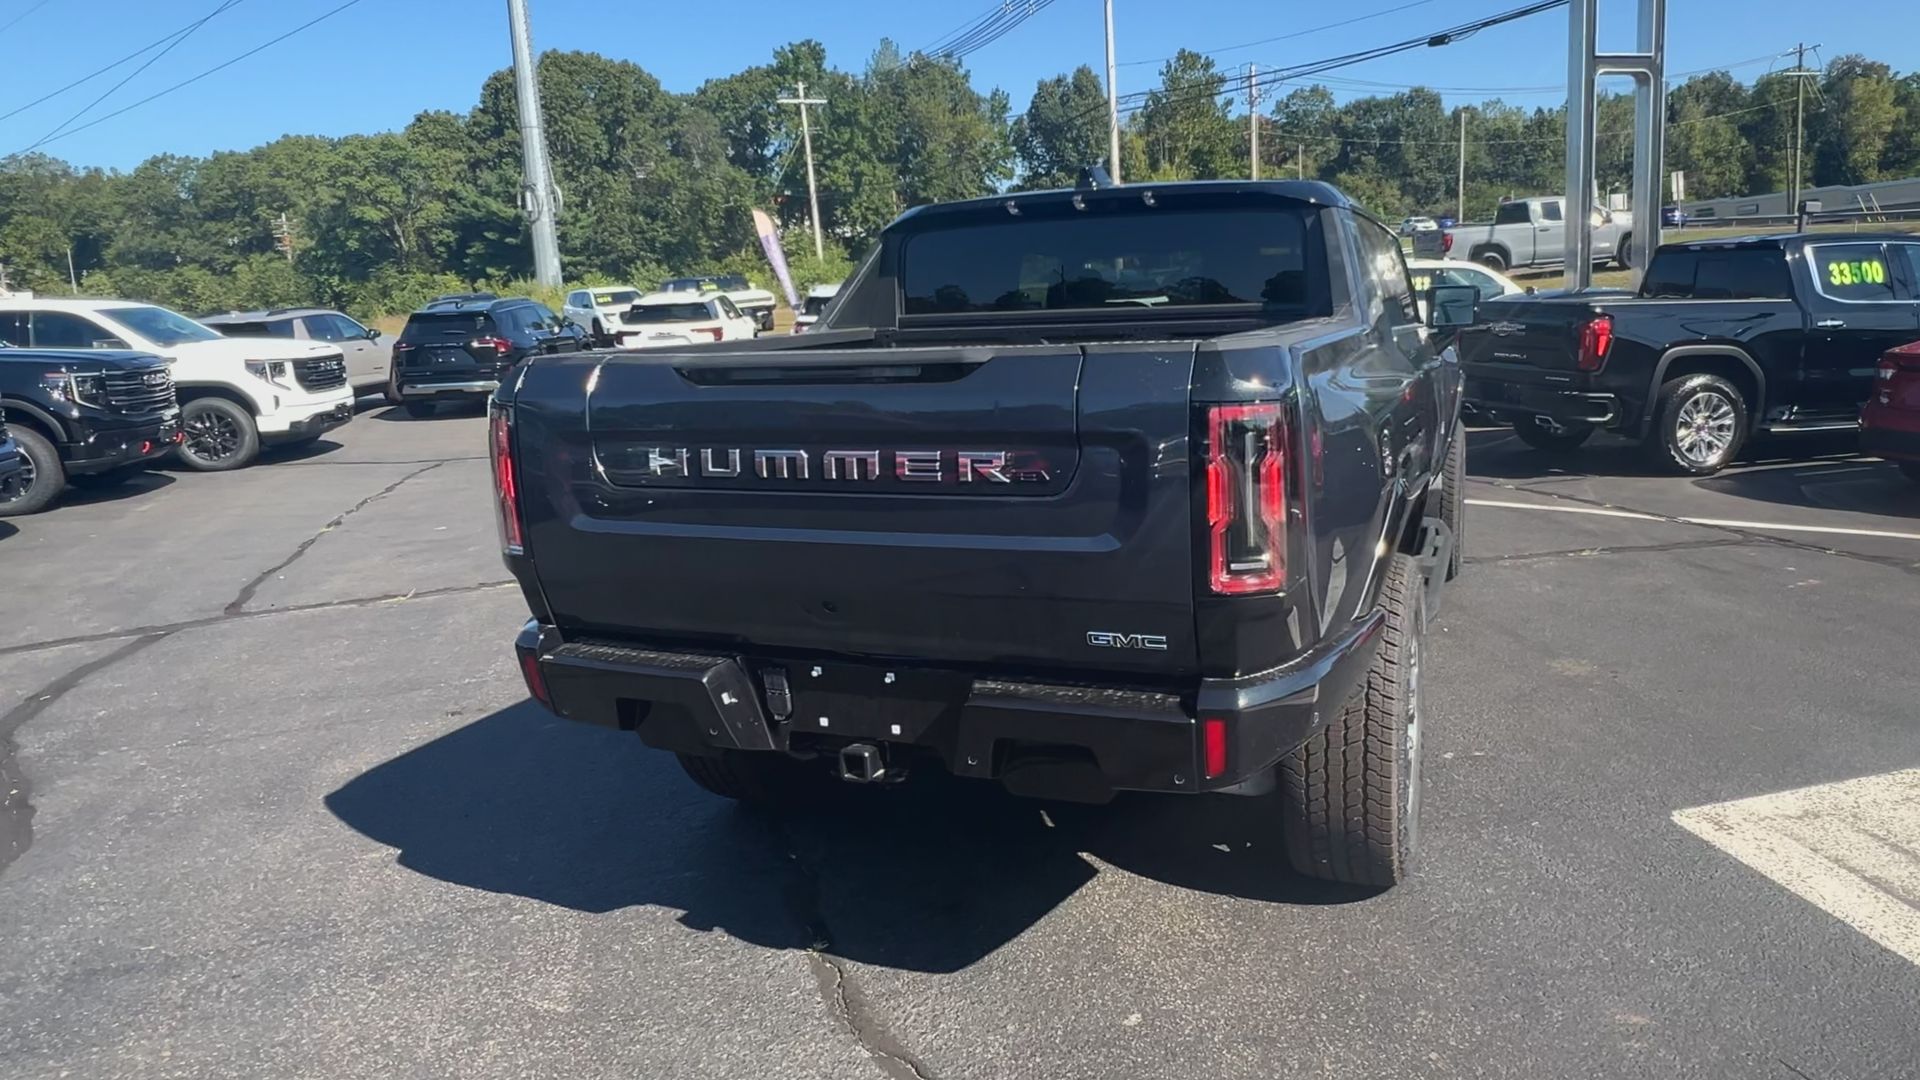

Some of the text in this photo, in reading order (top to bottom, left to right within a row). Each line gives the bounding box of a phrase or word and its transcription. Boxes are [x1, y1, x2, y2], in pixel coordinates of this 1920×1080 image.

[1828, 261, 1884, 286] 33500
[648, 448, 1010, 483] HUMMER
[1087, 631, 1167, 650] GMC
